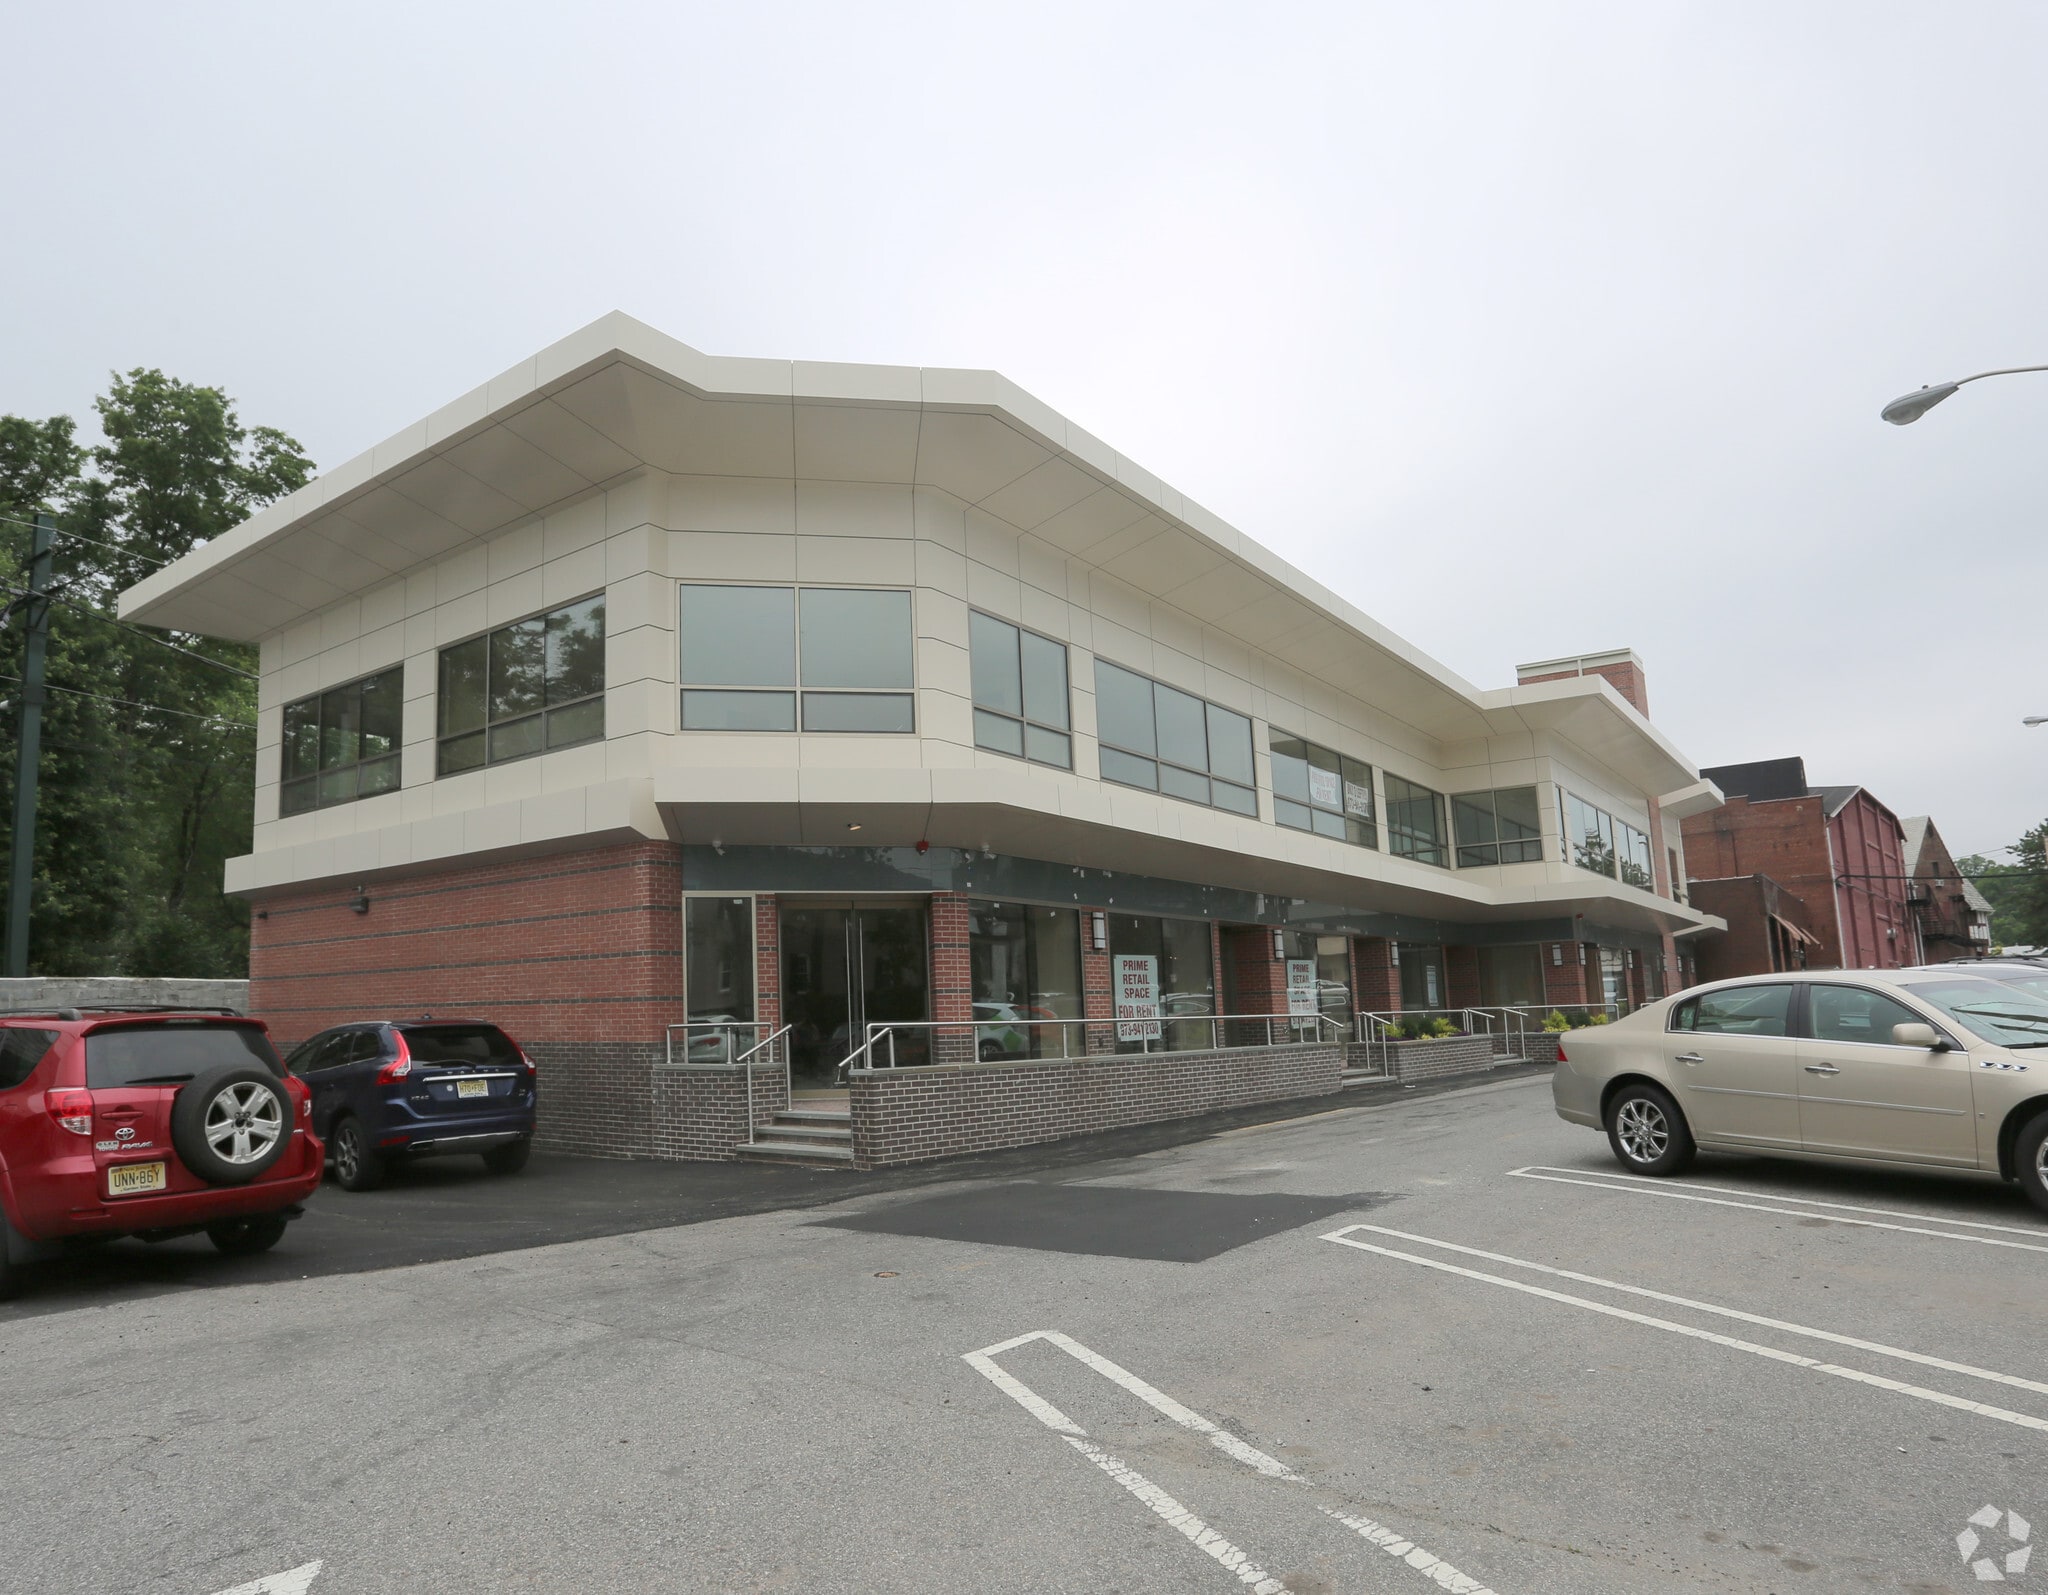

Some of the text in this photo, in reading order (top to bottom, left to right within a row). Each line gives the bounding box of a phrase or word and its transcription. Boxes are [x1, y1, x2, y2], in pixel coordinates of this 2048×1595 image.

[1123, 960, 1148, 971] PRIME
[1292, 964, 1310, 973] PRIME
[1123, 974, 1150, 985] RETAIL
[1124, 987, 1150, 999] SPACE
[1118, 1004, 1157, 1018] FOR RENT
